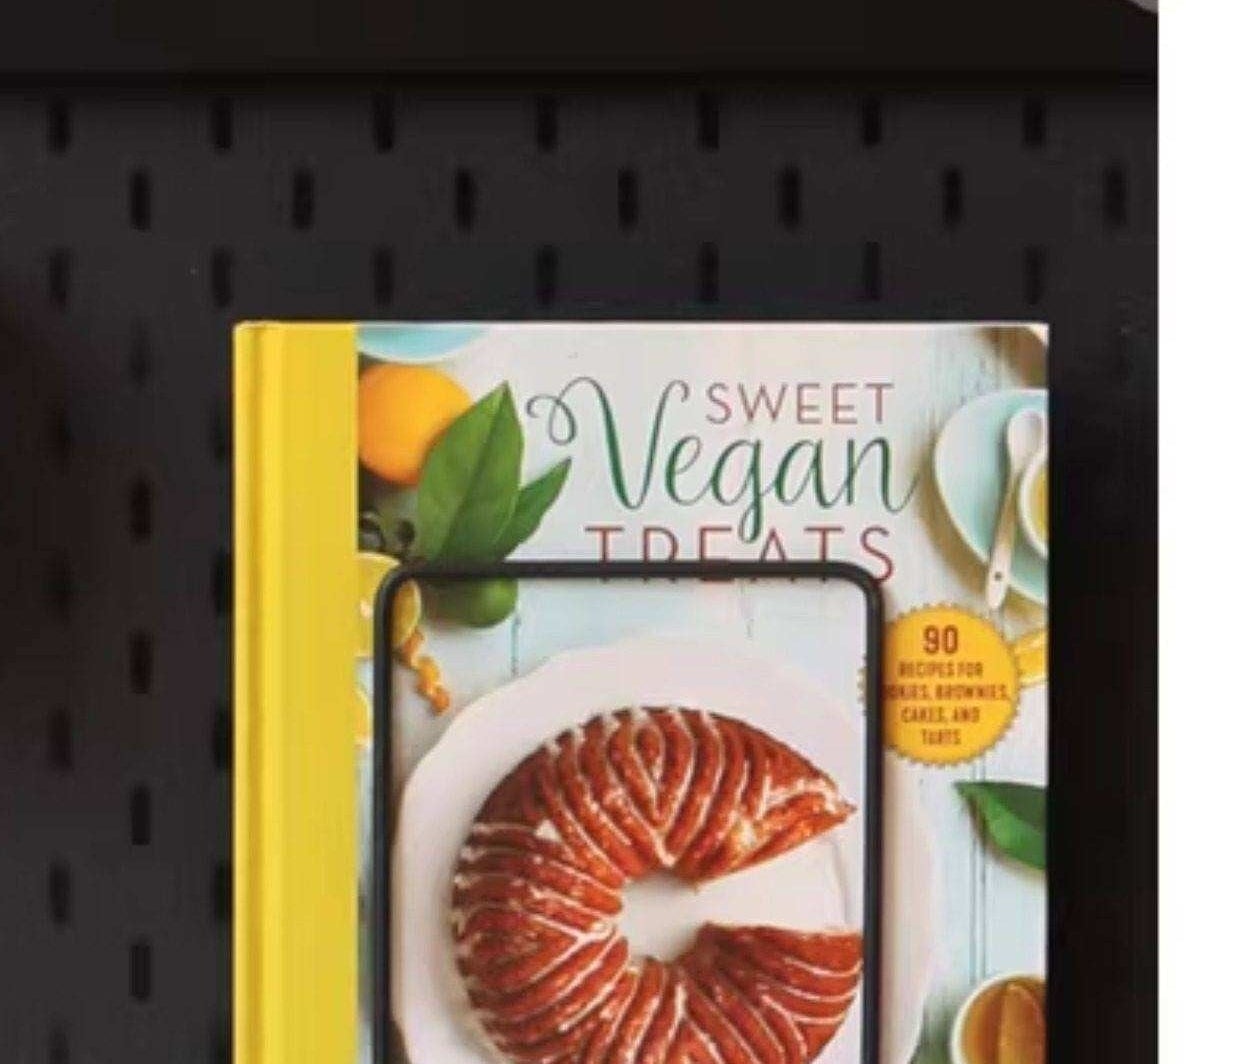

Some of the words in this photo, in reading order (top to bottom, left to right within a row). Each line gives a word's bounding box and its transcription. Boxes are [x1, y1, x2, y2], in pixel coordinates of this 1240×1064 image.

[705, 381, 895, 425] SWEET
[526, 376, 920, 544] Vegan
[584, 525, 895, 584] TREATS
[922, 624, 959, 655] 90
[899, 661, 955, 679] RECIPES
[957, 661, 984, 679] FOR
[952, 706, 981, 723] AND
